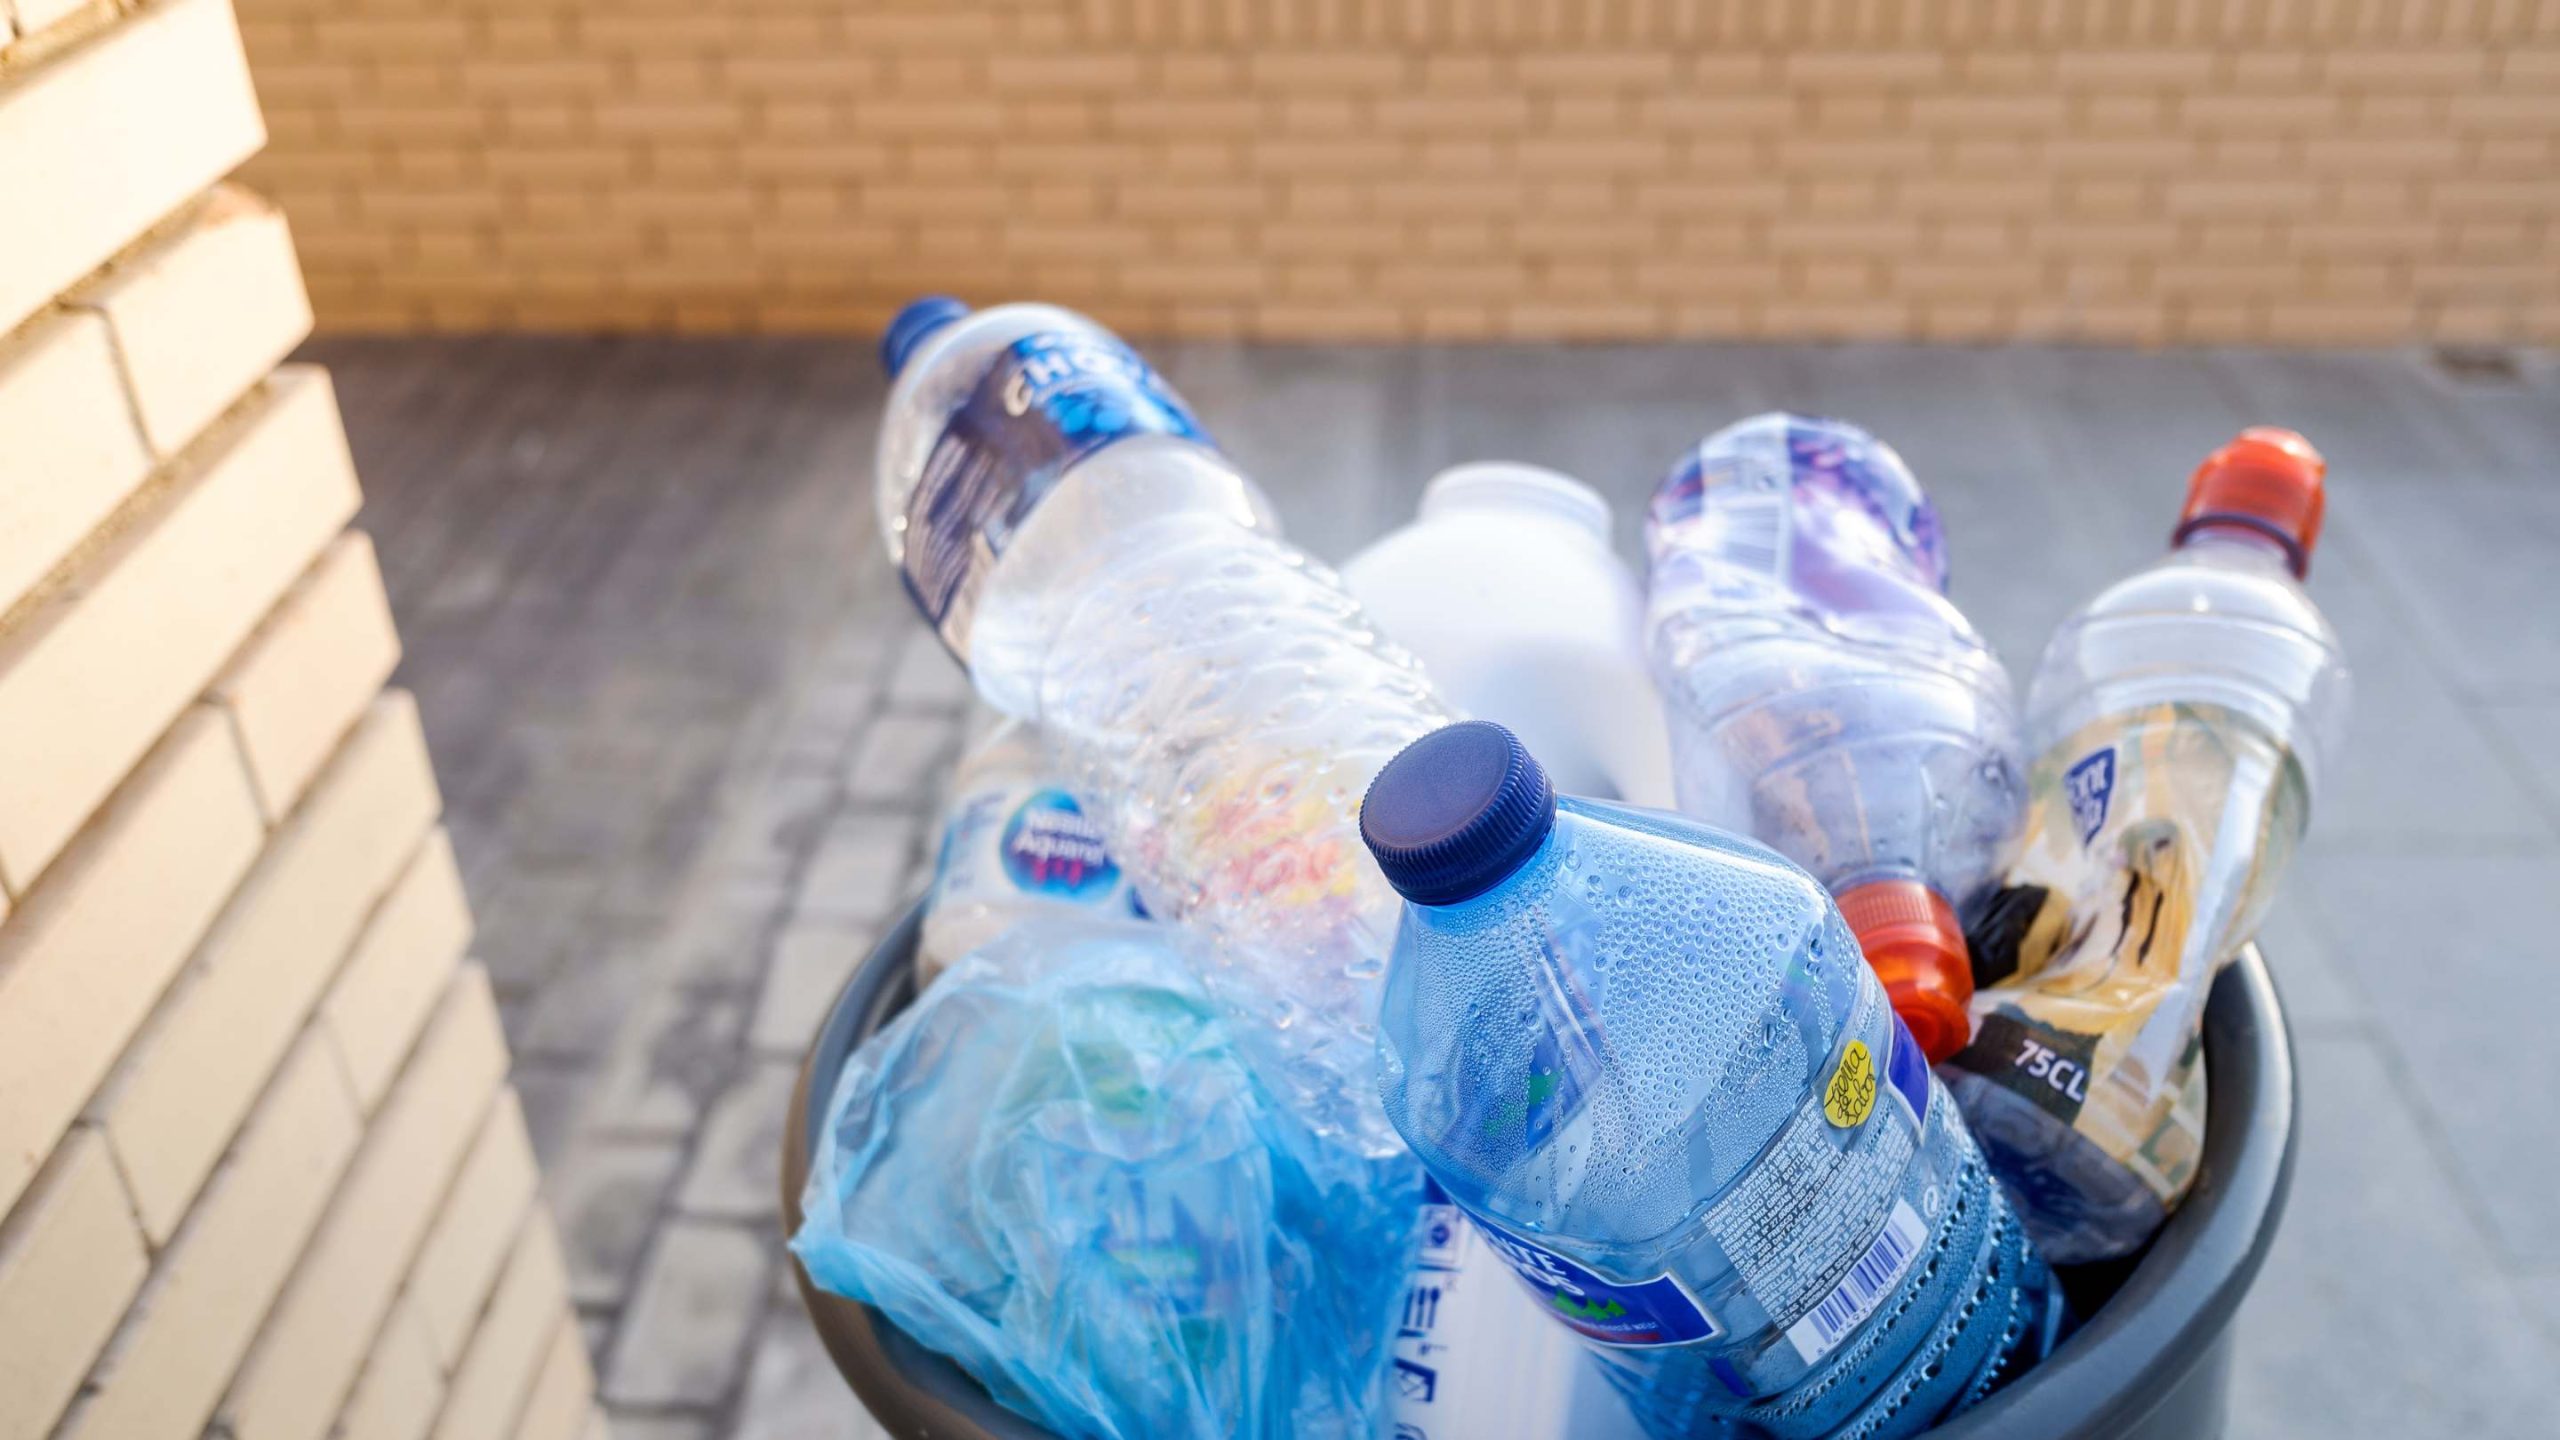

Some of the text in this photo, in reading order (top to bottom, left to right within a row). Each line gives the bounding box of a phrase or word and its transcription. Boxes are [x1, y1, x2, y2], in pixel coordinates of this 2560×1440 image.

[2015, 1039, 2084, 1102] 75CL
[1700, 1184, 1742, 1223] MANANTIAL
[1741, 1162, 1766, 1188] MONTE
[1799, 1094, 1818, 1117] PINOS
[1705, 1108, 1817, 1230] SPRING CAPTADA A UNA ALTITUD DE
[1721, 1197, 1764, 1239] ENVASADO
[1762, 1177, 1783, 1200] POR/
[1781, 1141, 1811, 1181] BOTTLED
[1768, 1168, 1781, 1183] AT
[1795, 1115, 1821, 1150] ALTITUDE
[1720, 1218, 1753, 1250] PREMIUM
[1752, 1205, 1768, 1221] MIX
[1815, 1137, 1825, 1150] DE
[1724, 1146, 1828, 1256] SORIA S/N ALMAZÁN (SORIA) SPAIN
[1733, 1257, 1745, 1270] EN
[1743, 1236, 1768, 1260] LUGAR
[1766, 1212, 1793, 1240] FRESCO
[1797, 1189, 1815, 1210] SECO
[1831, 1156, 1839, 1167] IN
[1737, 1256, 1756, 1275] COOL
[1755, 1241, 1772, 1259] AND
[1771, 1228, 1787, 1245] DRY
[1785, 1207, 1807, 1232] PLACE
[1837, 1159, 1846, 1172] DE
[1843, 1149, 1852, 1161] LA
[1778, 1238, 1799, 1259] FROM
[1797, 1218, 1817, 1242] LIGHT
[1815, 1204, 1830, 1222] AND
[1828, 1177, 1850, 1208] STRONG
[1808, 1213, 1843, 1251] CONSUMED
[1742, 1263, 1759, 1282] LUZ
[1758, 1241, 1785, 1267] SOLAR
[1790, 1222, 1803, 1237] DE
[1801, 1194, 1829, 1226] OLORES
[1772, 1302, 1799, 1324] DIETAS
[1798, 1277, 1825, 1304] POBRES
[1824, 1267, 1835, 1280] EN
[1784, 1287, 1804, 1307] AGUA
[1798, 1268, 1844, 1313] LABORATORIO
